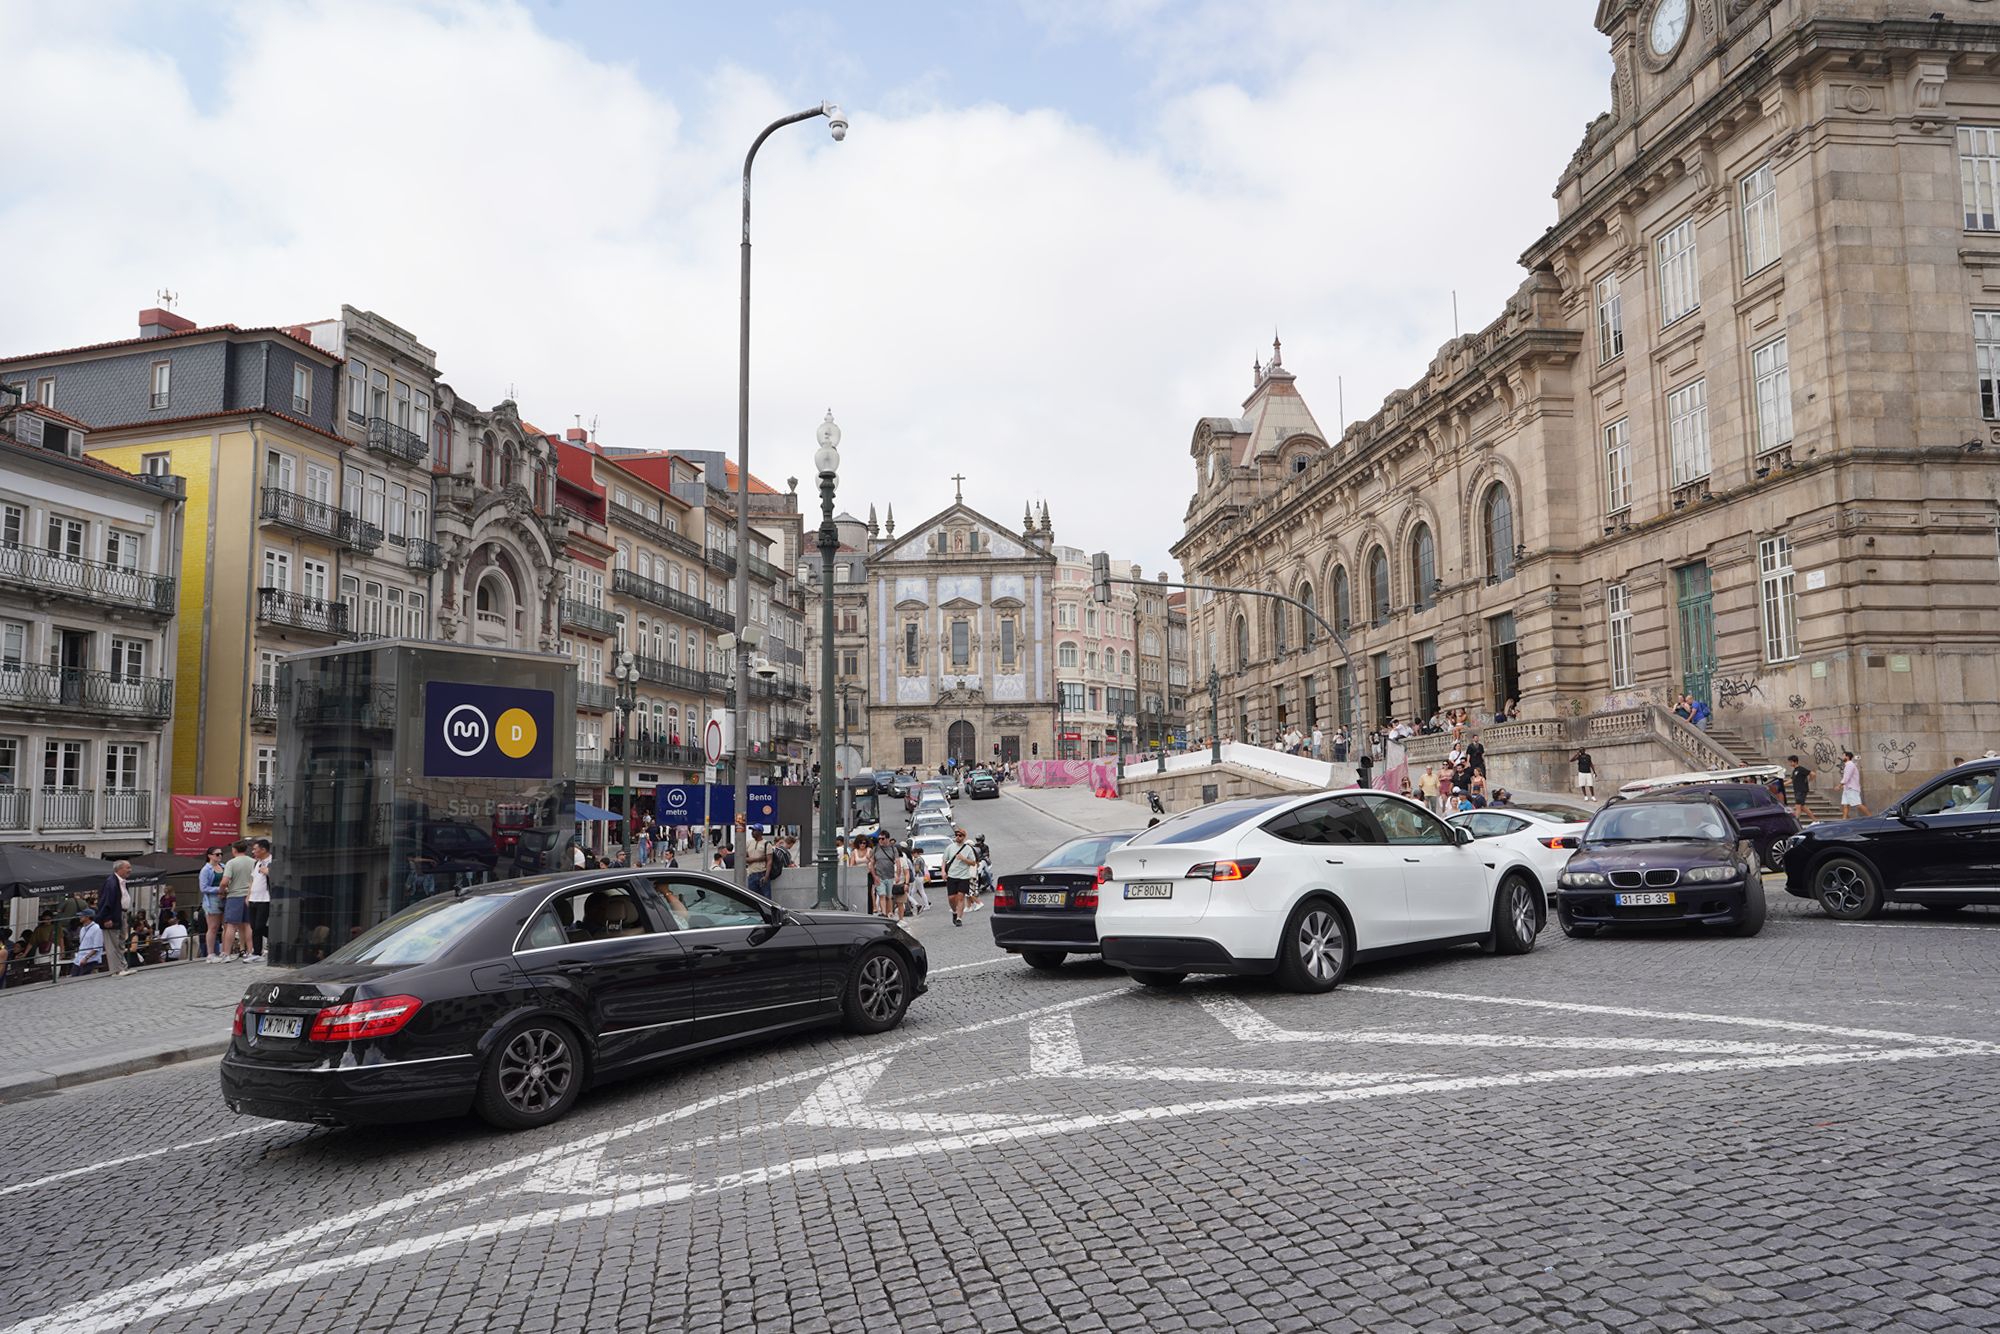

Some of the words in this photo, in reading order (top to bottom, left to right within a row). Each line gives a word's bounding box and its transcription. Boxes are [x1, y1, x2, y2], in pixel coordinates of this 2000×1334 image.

[511, 725, 522, 742] D
[749, 793, 772, 801] Bento
[448, 799, 480, 816] São
[665, 808, 688, 816] metro
[55, 843, 86, 855] Invicta
[1621, 894, 1669, 904] 31-FB-35
